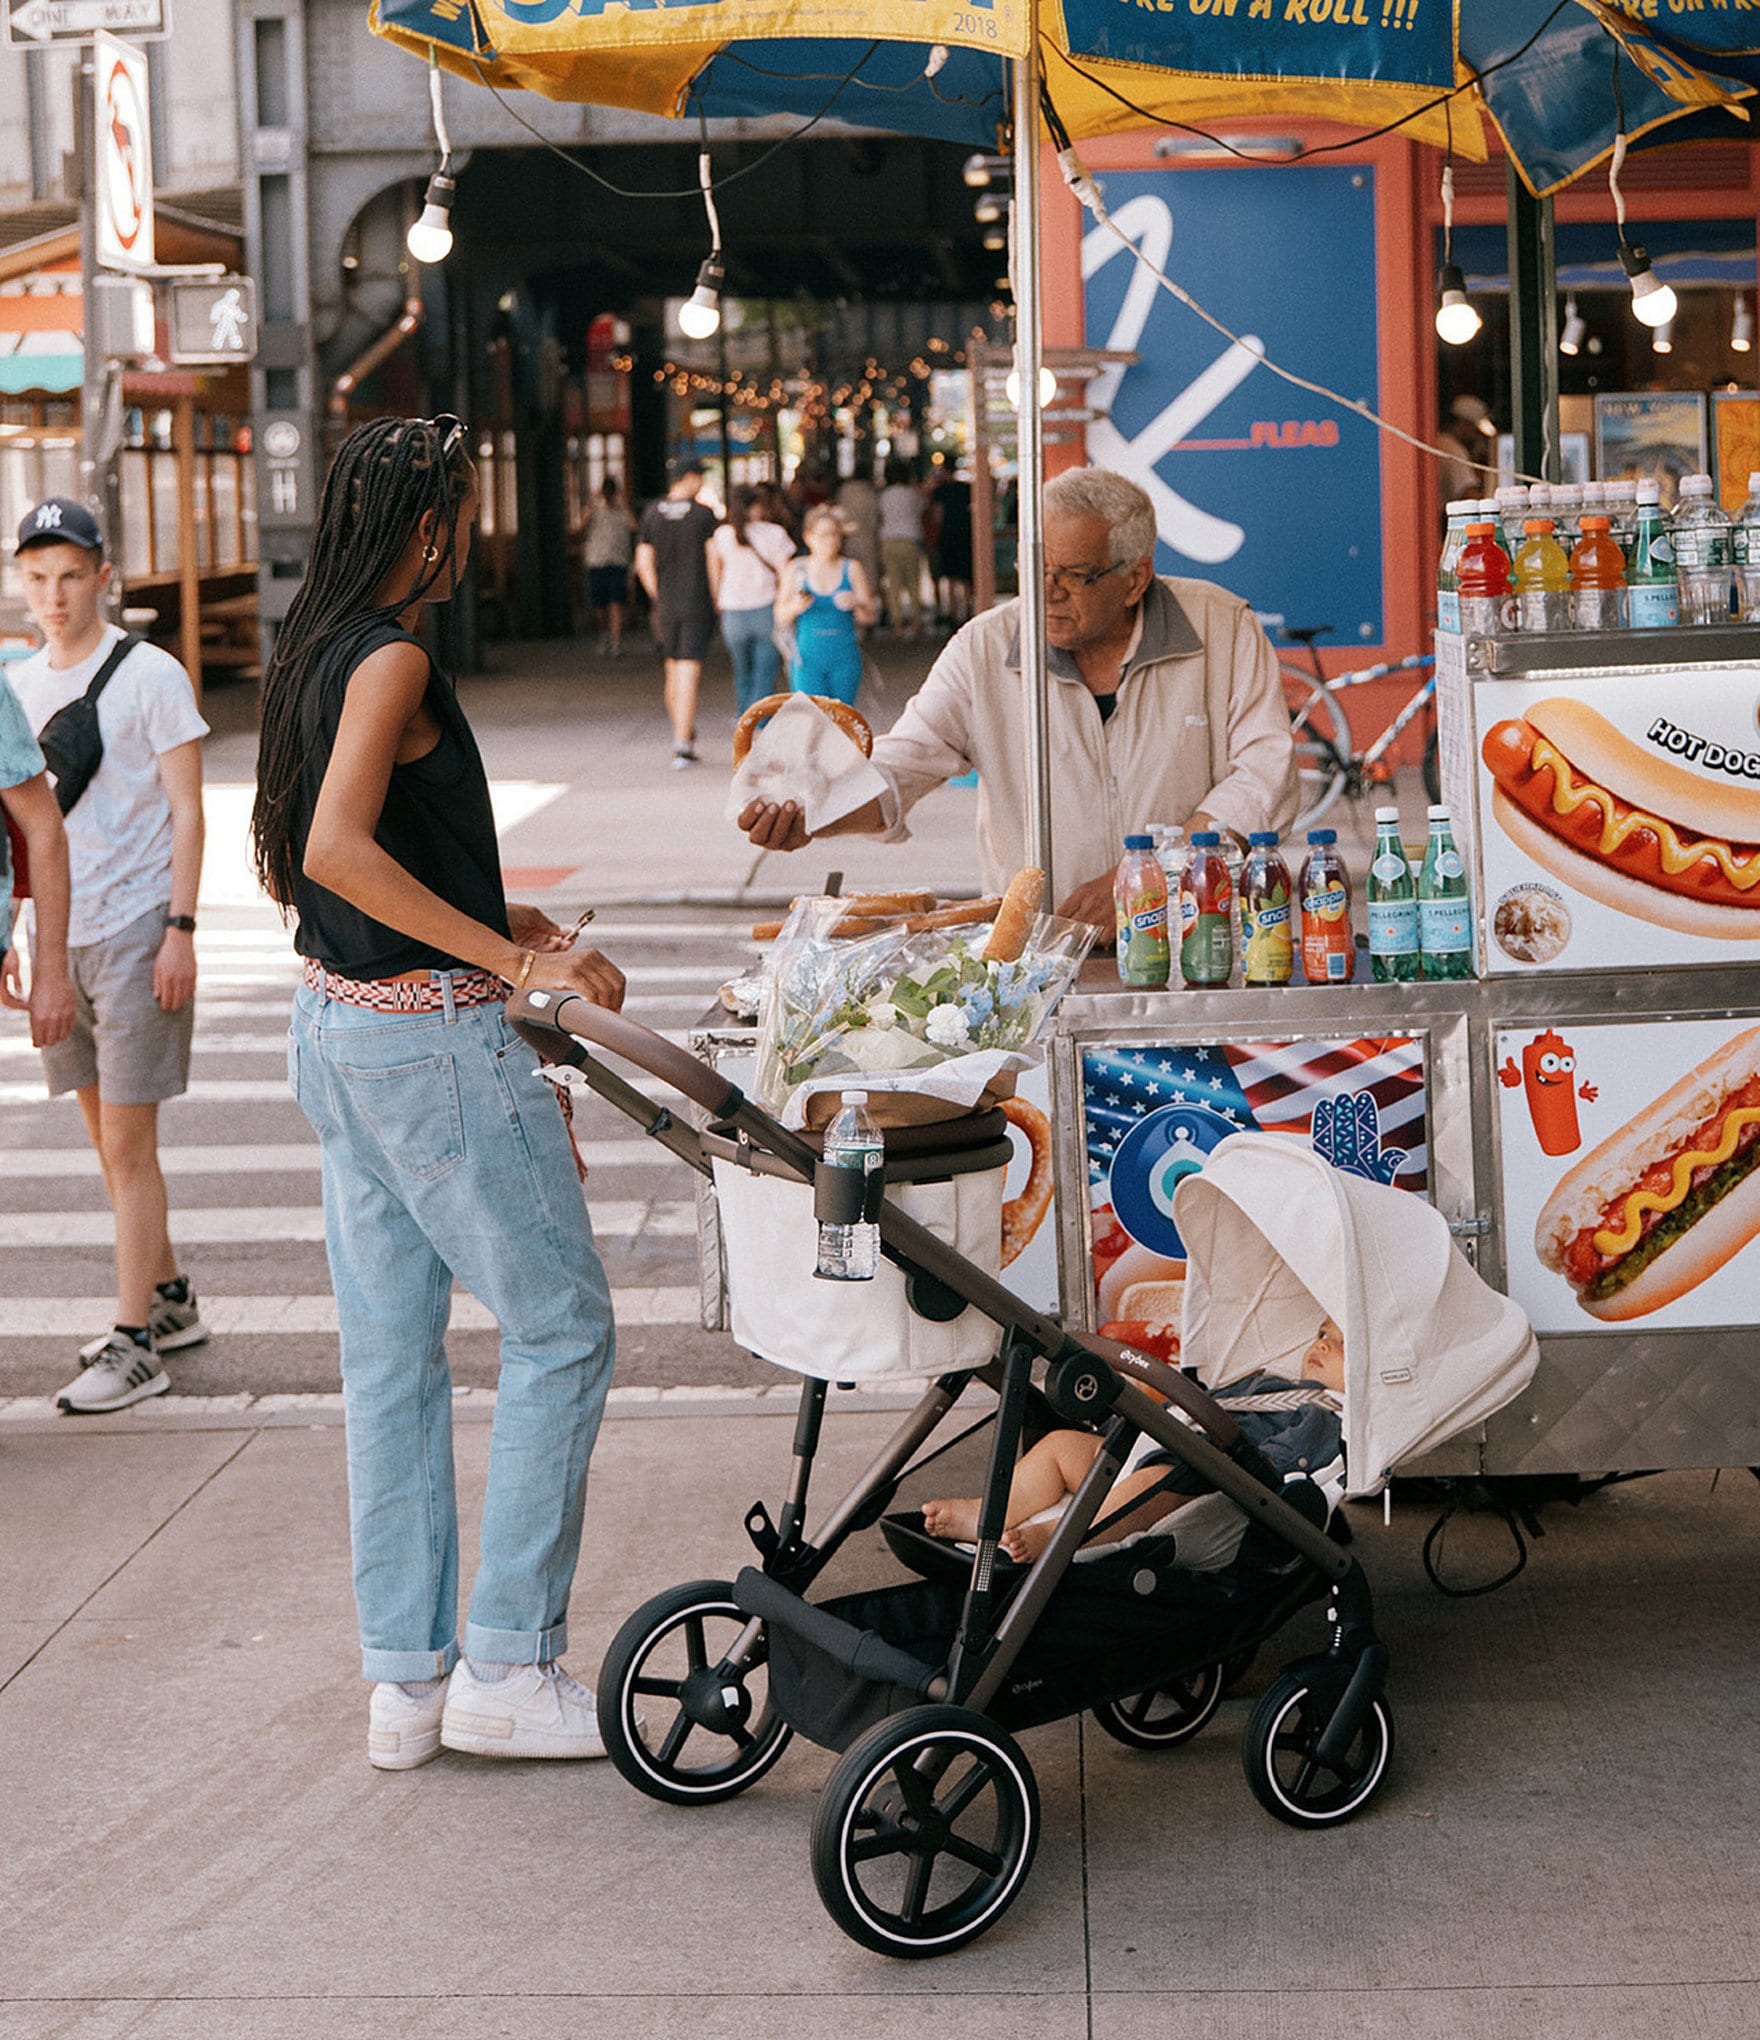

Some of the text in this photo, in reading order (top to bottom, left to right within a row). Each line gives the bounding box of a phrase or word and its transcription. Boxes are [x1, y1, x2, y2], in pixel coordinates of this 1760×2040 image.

[28, 4, 151, 28] ONE WAY
[1248, 0, 1272, 19] A
[1284, 0, 1369, 24] ROLL
[953, 12, 997, 39] 2018
[1250, 420, 1339, 447] FLEAS
[36, 504, 62, 529] NY
[1647, 717, 1707, 761] HOT
